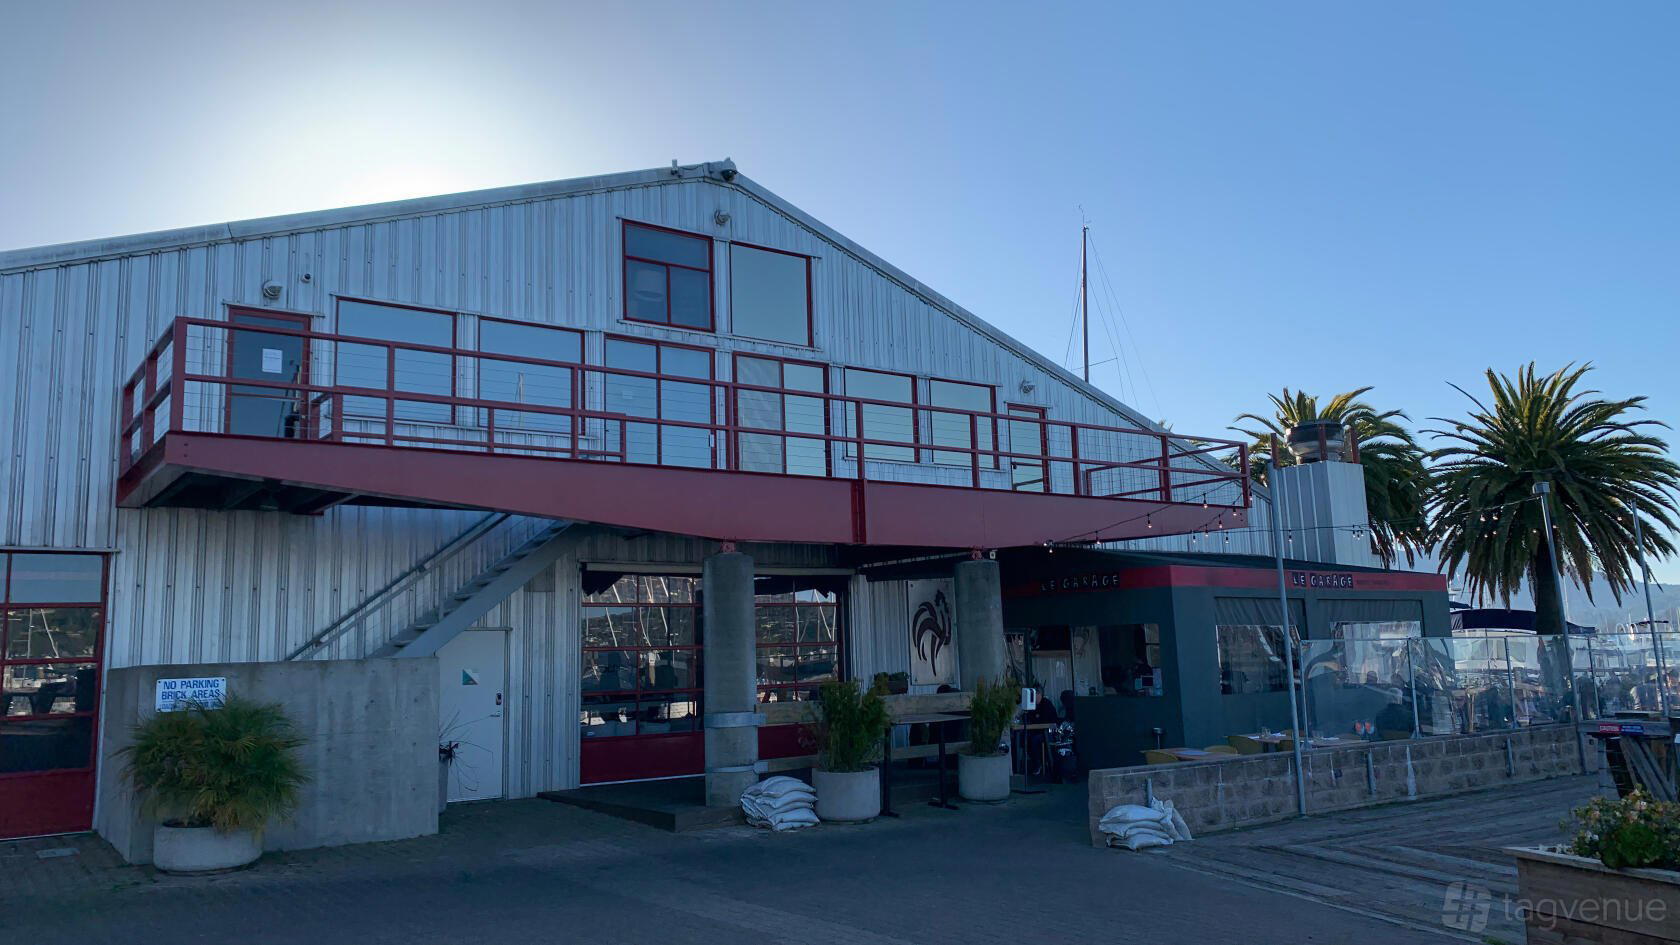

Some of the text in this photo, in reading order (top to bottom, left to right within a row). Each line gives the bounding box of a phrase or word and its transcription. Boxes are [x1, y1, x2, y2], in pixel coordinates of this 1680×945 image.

[1041, 579, 1055, 591] LE
[1293, 575, 1306, 585] LE
[1311, 574, 1353, 587] GARAGE
[163, 679, 220, 690] NO PARKING
[161, 689, 220, 700] BRICK AREAS
